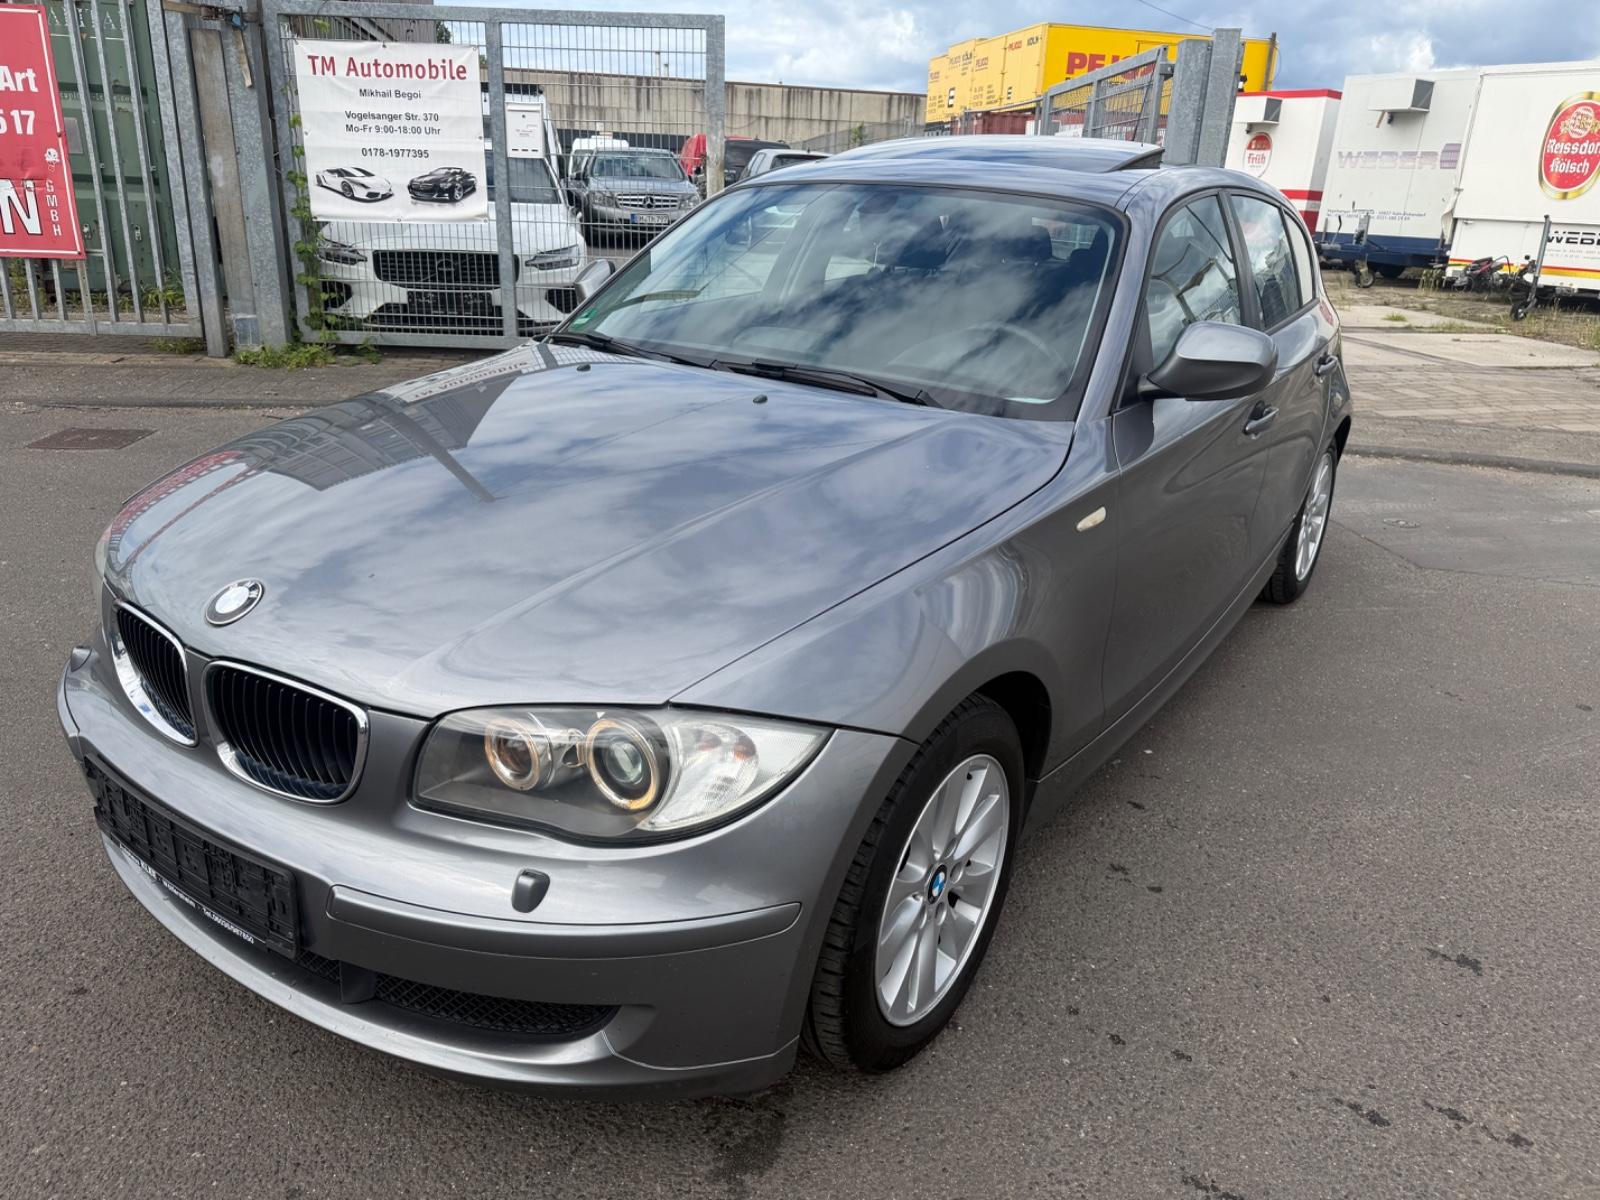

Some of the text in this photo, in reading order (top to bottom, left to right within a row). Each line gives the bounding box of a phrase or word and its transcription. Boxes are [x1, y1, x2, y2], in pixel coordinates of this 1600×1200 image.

[307, 55, 467, 80] TM Automobile
[0, 65, 39, 92] Art
[359, 88, 421, 101] Mikhail Begoi
[345, 110, 439, 123] Vogelsanger Str. 370
[345, 124, 441, 135] Mo-Fr 9:00-18:00 Uhr
[361, 147, 430, 159] 0178-1977395
[1338, 150, 1439, 169] WEBER
[1550, 157, 1590, 176] Kölsch
[1546, 230, 1600, 246] WEB
